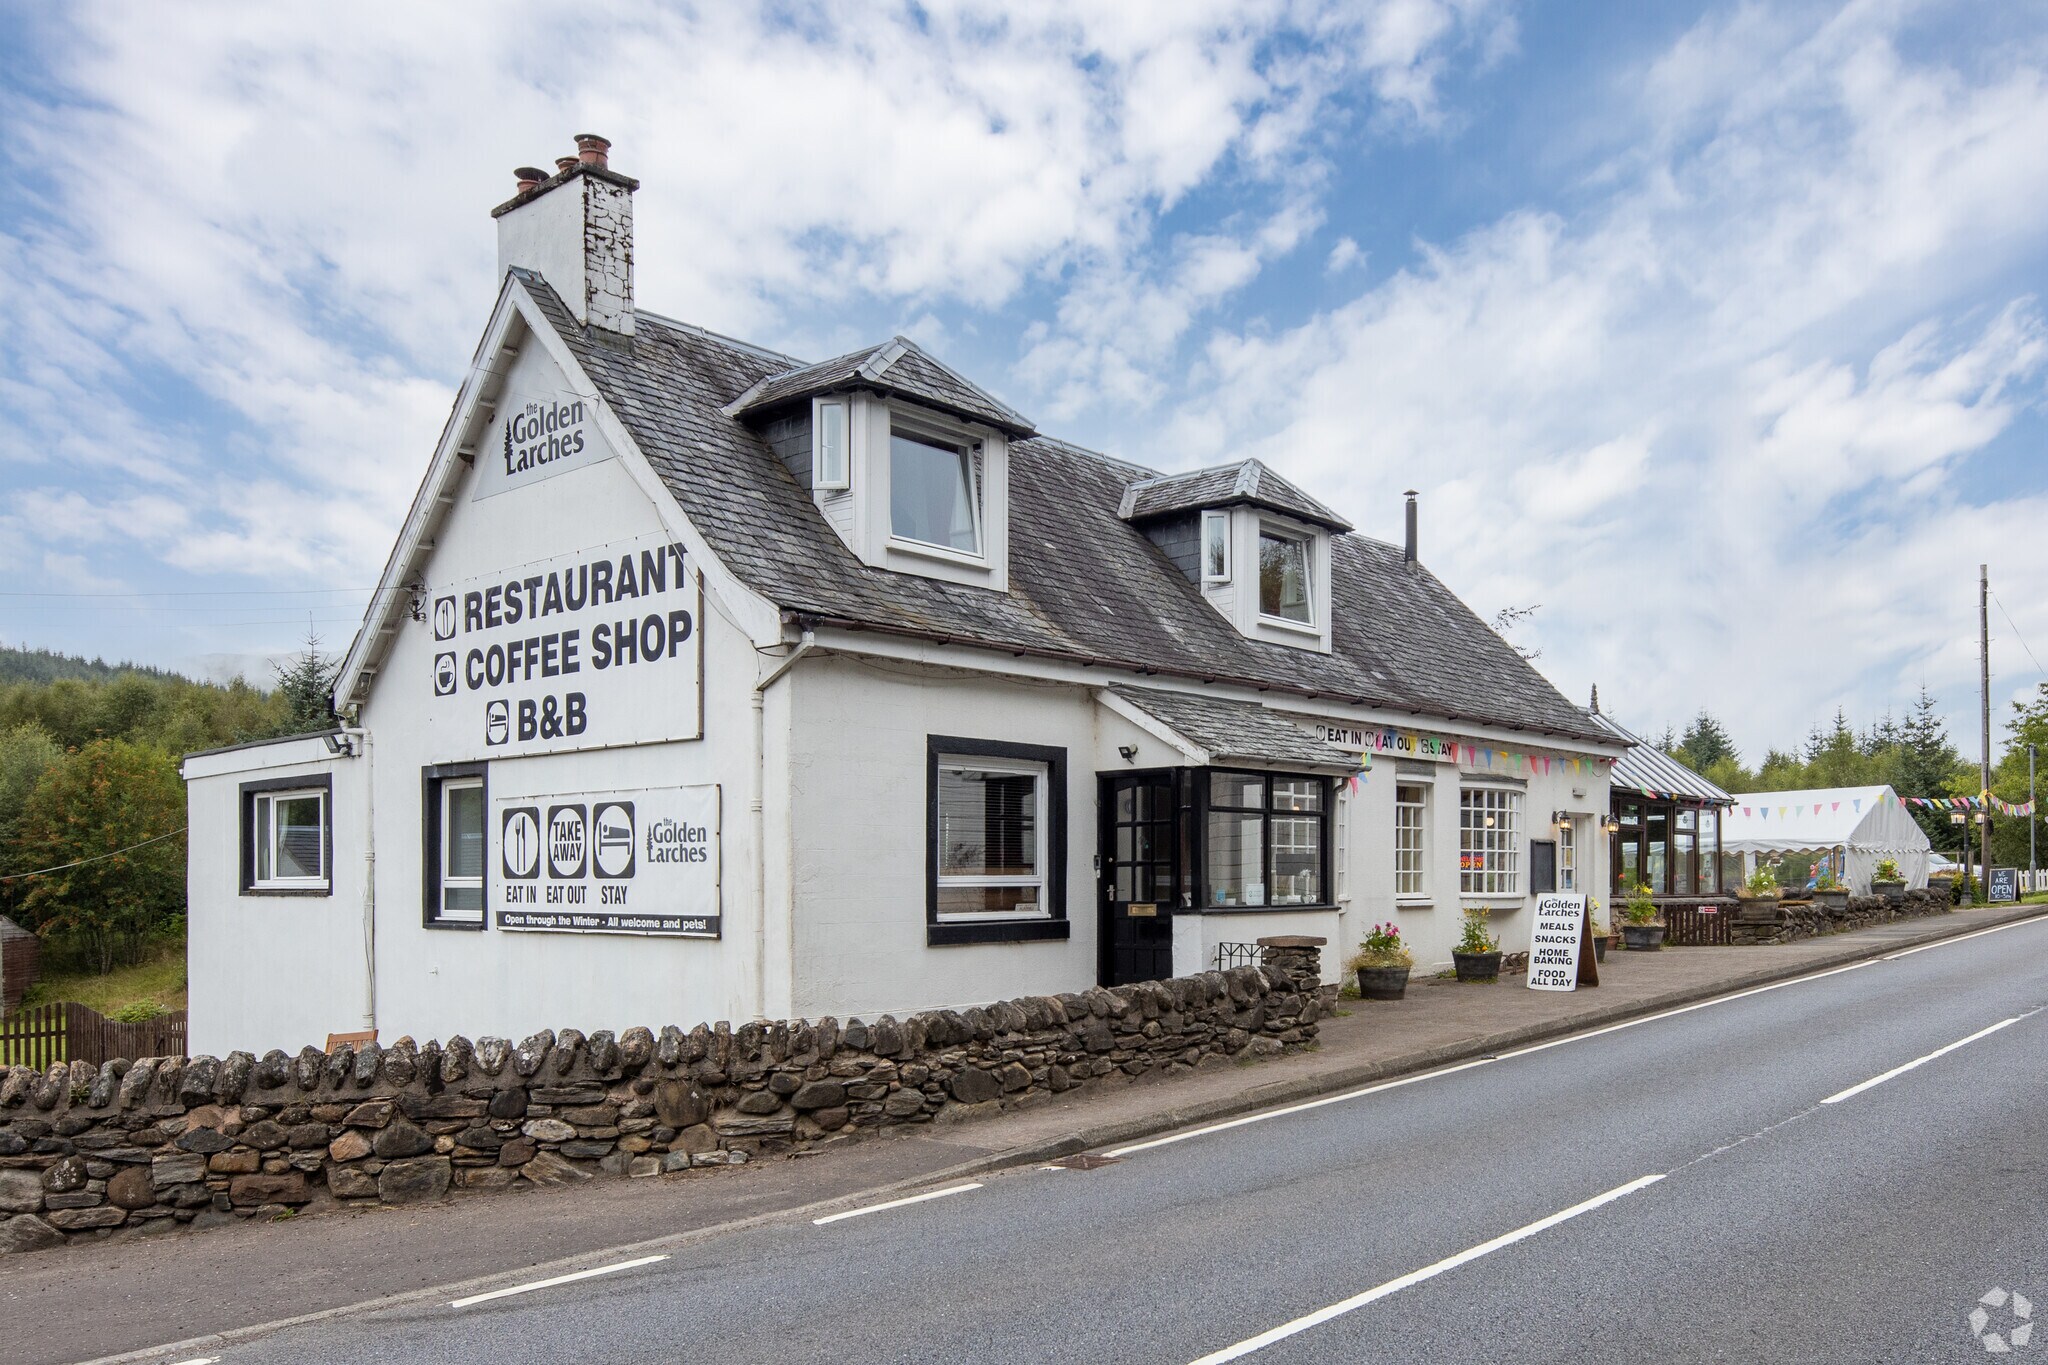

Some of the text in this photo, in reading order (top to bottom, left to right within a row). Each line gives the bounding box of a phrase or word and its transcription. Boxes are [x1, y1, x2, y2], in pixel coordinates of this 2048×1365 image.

[526, 402, 538, 416] the
[513, 400, 584, 444] Golden
[506, 429, 585, 476] Larches
[464, 542, 689, 633] RESTAURANT
[465, 609, 692, 691] COFFEE SHOP
[517, 691, 588, 742] B&B
[1327, 728, 1348, 743] EAT
[1351, 731, 1362, 745] IN
[1397, 737, 1417, 752] OU
[663, 817, 673, 827] the
[553, 820, 581, 842] TAKE
[652, 821, 707, 844] Golden
[553, 842, 582, 862] AWAY
[647, 843, 708, 863] Larches
[506, 885, 628, 905] EAT IN EAT OUT STAY
[1991, 885, 2012, 895] OPEN
[1539, 908, 1580, 917] Larches
[1544, 900, 1580, 909] Golden
[505, 914, 525, 925] Open
[526, 914, 556, 927] through
[558, 915, 571, 926] the
[572, 916, 600, 926] Winter
[607, 916, 618, 927] All
[621, 917, 660, 928] welcome
[662, 918, 680, 929] and
[682, 919, 707, 931] pets!
[1540, 922, 1574, 931] MEALS
[1535, 935, 1576, 944] SNACKS
[1534, 956, 1573, 965] BAKING
[1539, 948, 1569, 957] HOME
[1531, 977, 1572, 987] ALL DAY
[1538, 969, 1566, 978] FOOD
